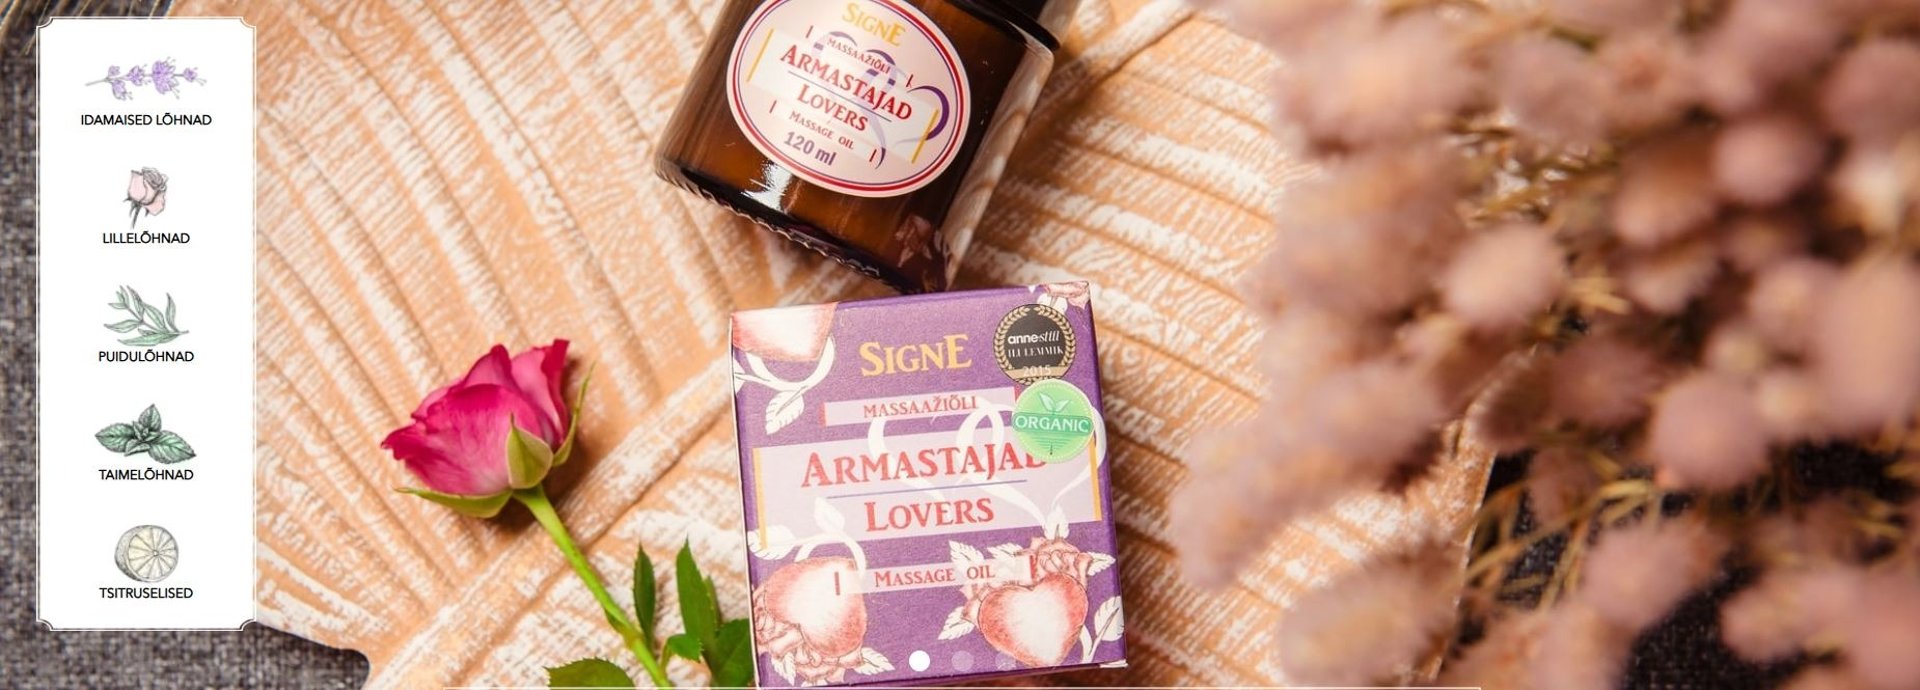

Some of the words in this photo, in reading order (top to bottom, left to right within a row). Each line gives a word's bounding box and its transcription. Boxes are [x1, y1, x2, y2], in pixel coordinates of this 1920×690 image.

[841, 2, 905, 47] SIGNE
[780, 44, 912, 120] ARMASTAJAD
[797, 83, 868, 131] LOVERS
[788, 110, 835, 139] MASSAGE
[837, 135, 855, 150] OIL
[784, 131, 815, 155] 120
[815, 146, 837, 166] ml
[859, 334, 972, 377] SIGNE
[1022, 365, 1052, 377] 2015
[863, 395, 979, 419] MASSAAŽIÕLI
[1015, 415, 1090, 433] ORGANIC
[864, 498, 994, 532] LOVERS
[875, 568, 955, 588] MASSAGE
[966, 564, 996, 580] OIL
